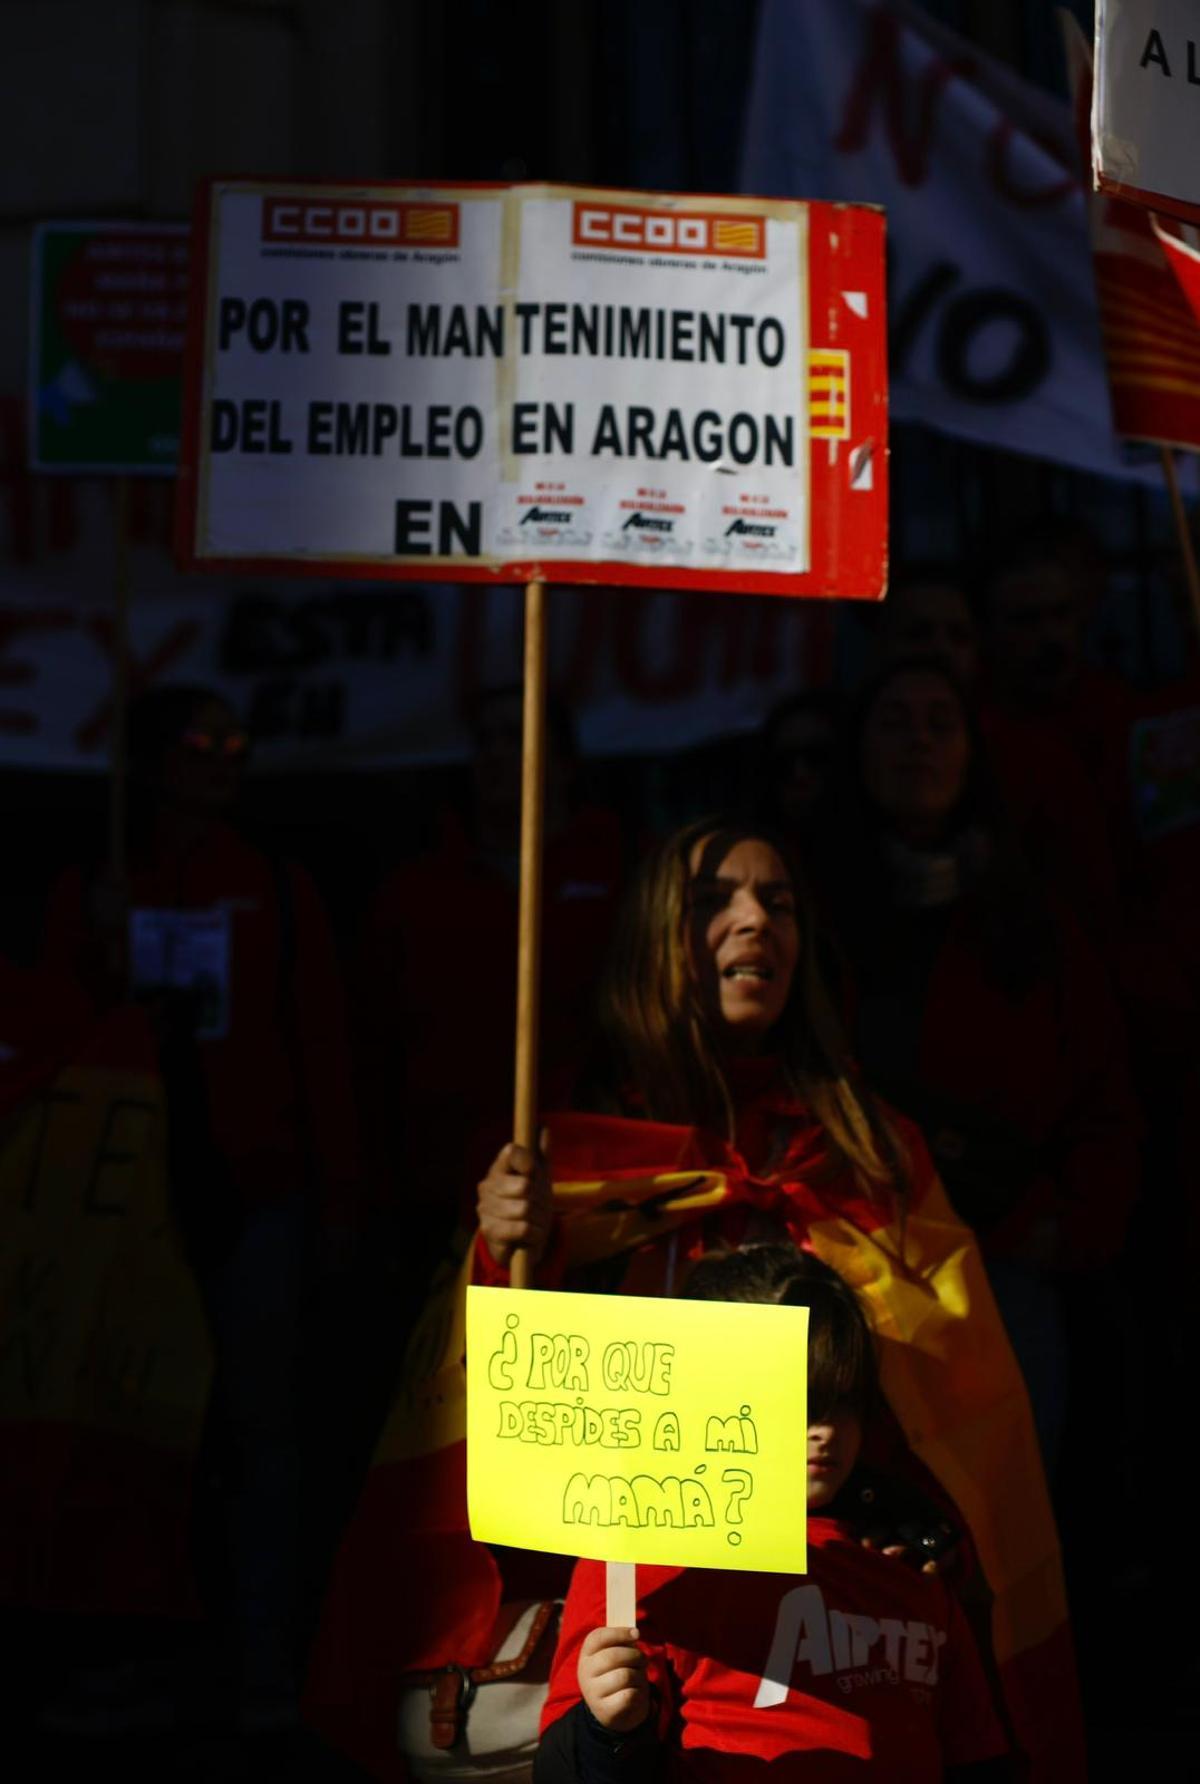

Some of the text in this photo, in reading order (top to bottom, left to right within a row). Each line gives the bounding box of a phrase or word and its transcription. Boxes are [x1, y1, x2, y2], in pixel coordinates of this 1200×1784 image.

[271, 206, 400, 239] CCOO
[579, 209, 708, 249] CCOO
[219, 298, 310, 354] POR
[338, 302, 391, 356] EL
[211, 399, 795, 468] DEL EMPLEO EN ARAGON
[394, 499, 482, 557] EN
[602, 1341, 675, 1396] QUE
[653, 1411, 681, 1452] A
